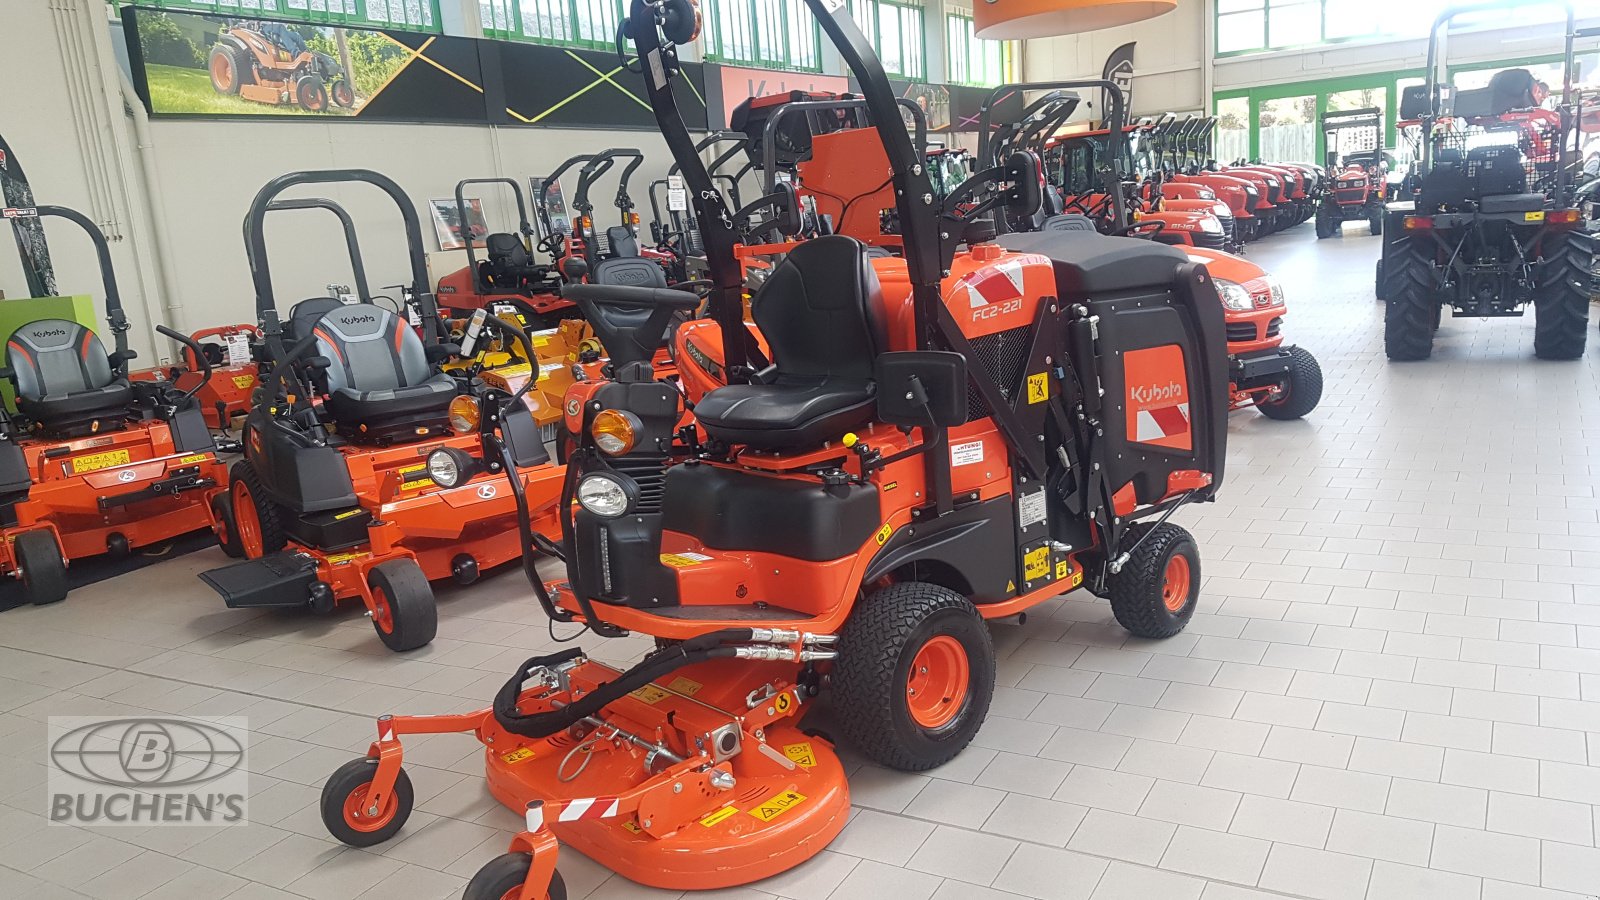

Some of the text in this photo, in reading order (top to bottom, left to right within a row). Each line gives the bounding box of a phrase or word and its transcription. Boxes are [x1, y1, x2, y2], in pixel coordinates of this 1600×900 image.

[341, 314, 375, 325] Kubota
[972, 299, 1022, 322] FC2-221
[33, 328, 66, 338] Kubota
[687, 341, 703, 363] Kubota
[1131, 380, 1182, 403] Kubota
